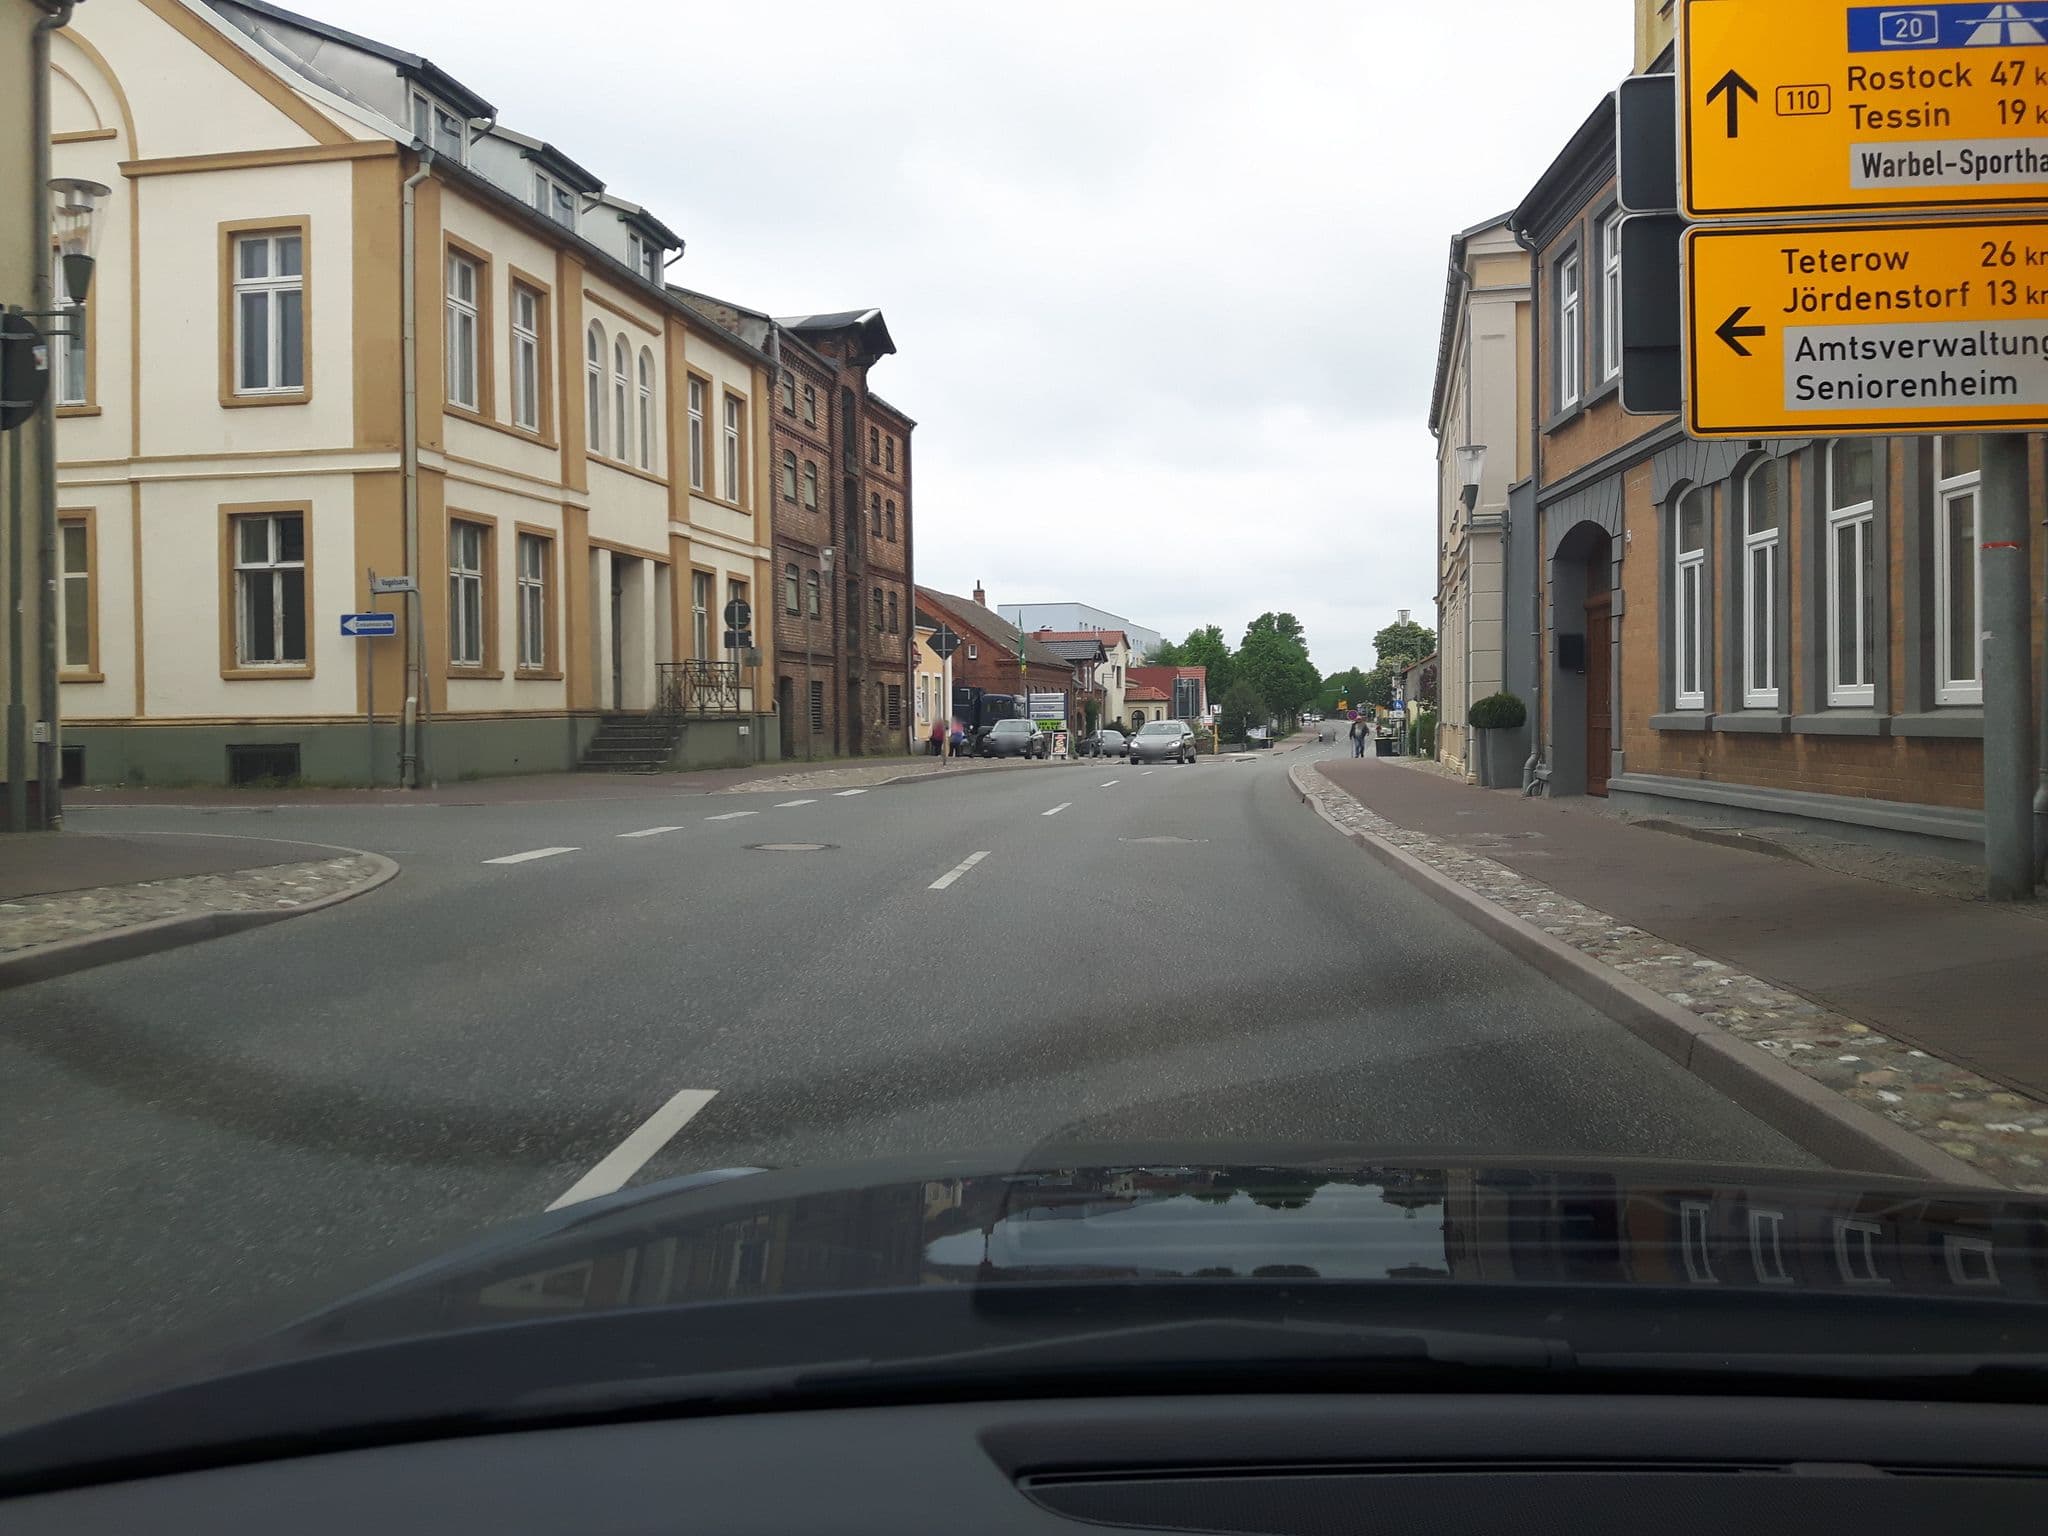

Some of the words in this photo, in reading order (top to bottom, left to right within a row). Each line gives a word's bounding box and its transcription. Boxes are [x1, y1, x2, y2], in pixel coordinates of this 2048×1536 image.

[1895, 17, 1923, 39] 20
[1848, 61, 1973, 92] Rostock
[1990, 60, 2025, 87] 47
[1786, 89, 1820, 111] 110
[1848, 101, 1950, 130] Tessin
[1997, 99, 2027, 126] 19
[1781, 247, 1910, 274] Teterow
[1980, 240, 2017, 268] 26
[1782, 280, 1970, 313] Jördenstorf
[1986, 279, 2017, 306] 13
[1795, 368, 2018, 401] Seniorenheim
